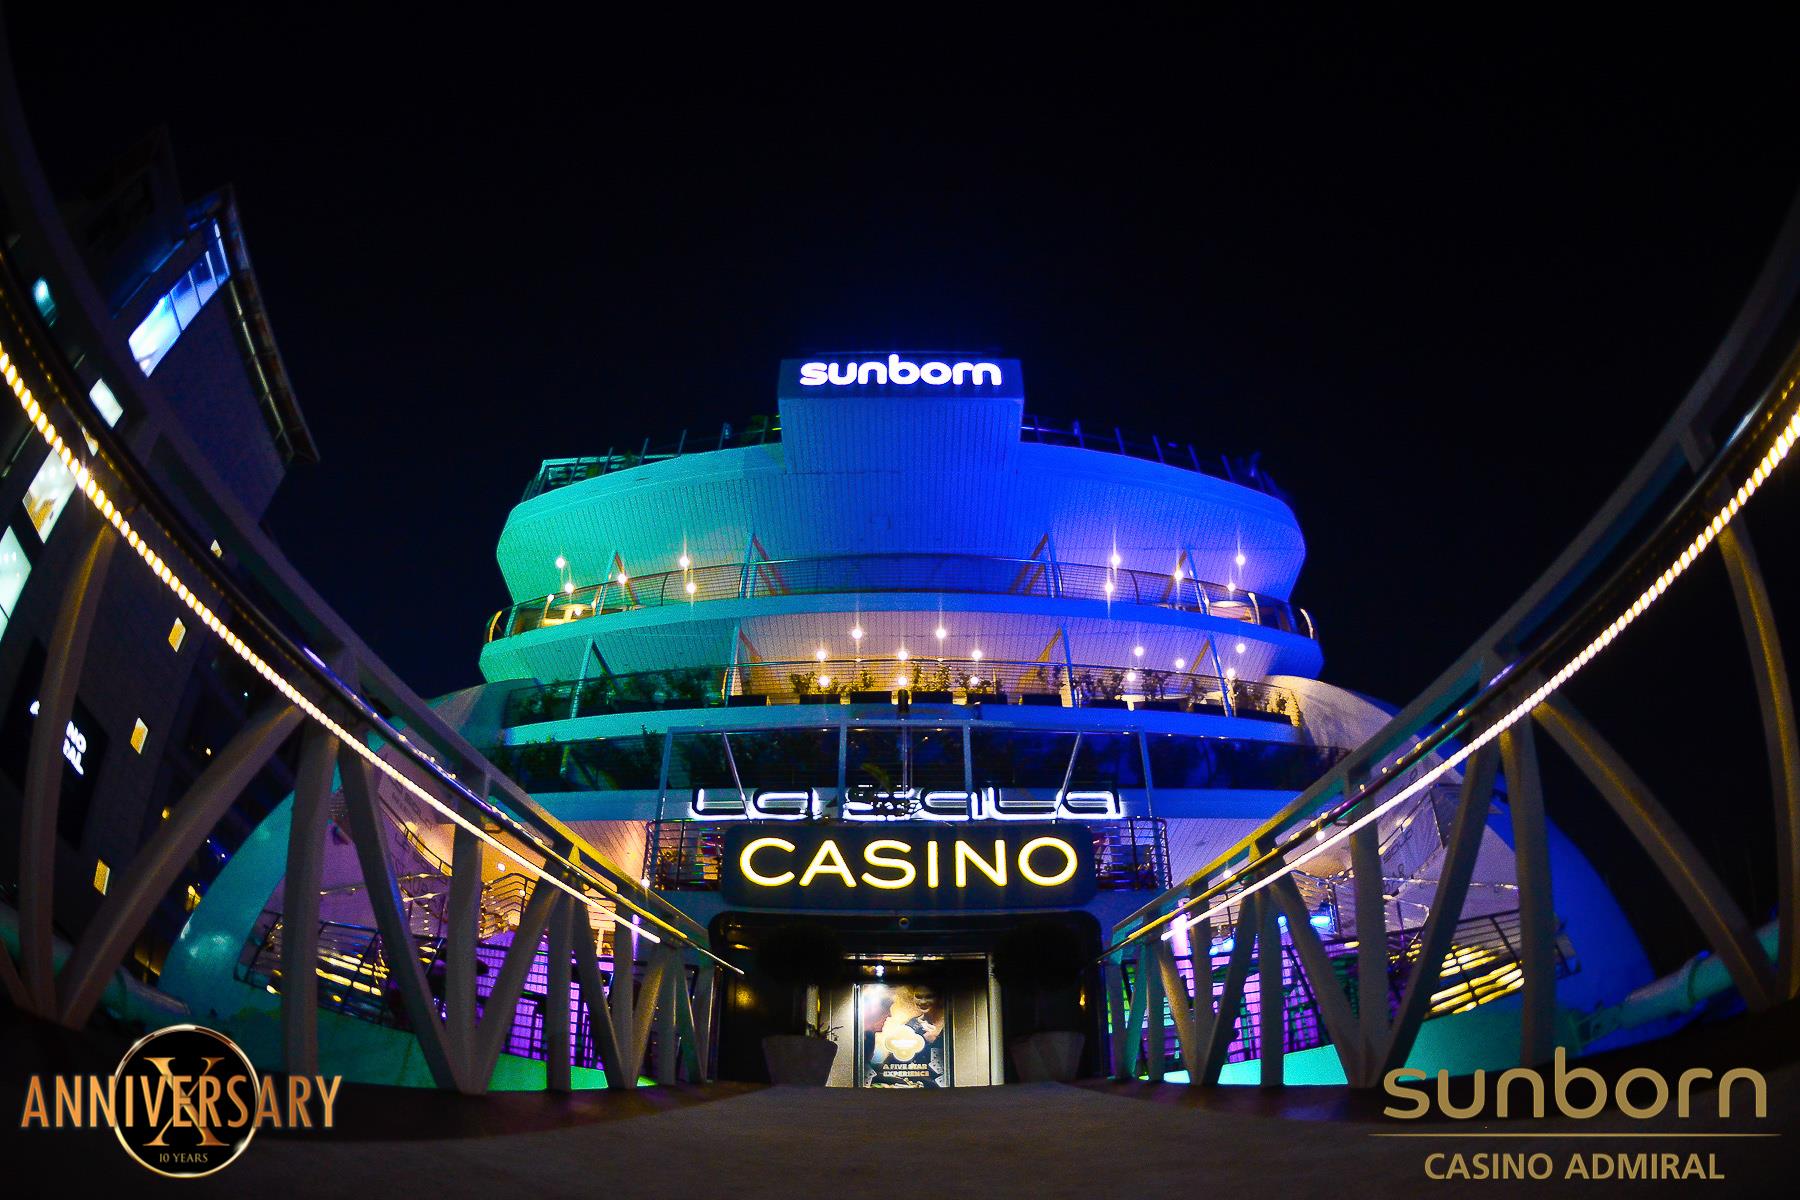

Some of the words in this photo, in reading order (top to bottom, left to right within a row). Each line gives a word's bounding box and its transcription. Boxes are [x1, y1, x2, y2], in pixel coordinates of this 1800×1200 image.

[799, 353, 1002, 386] sunborn
[739, 836, 1078, 890] CASINO
[883, 1070, 930, 1078] EXPERIENCE
